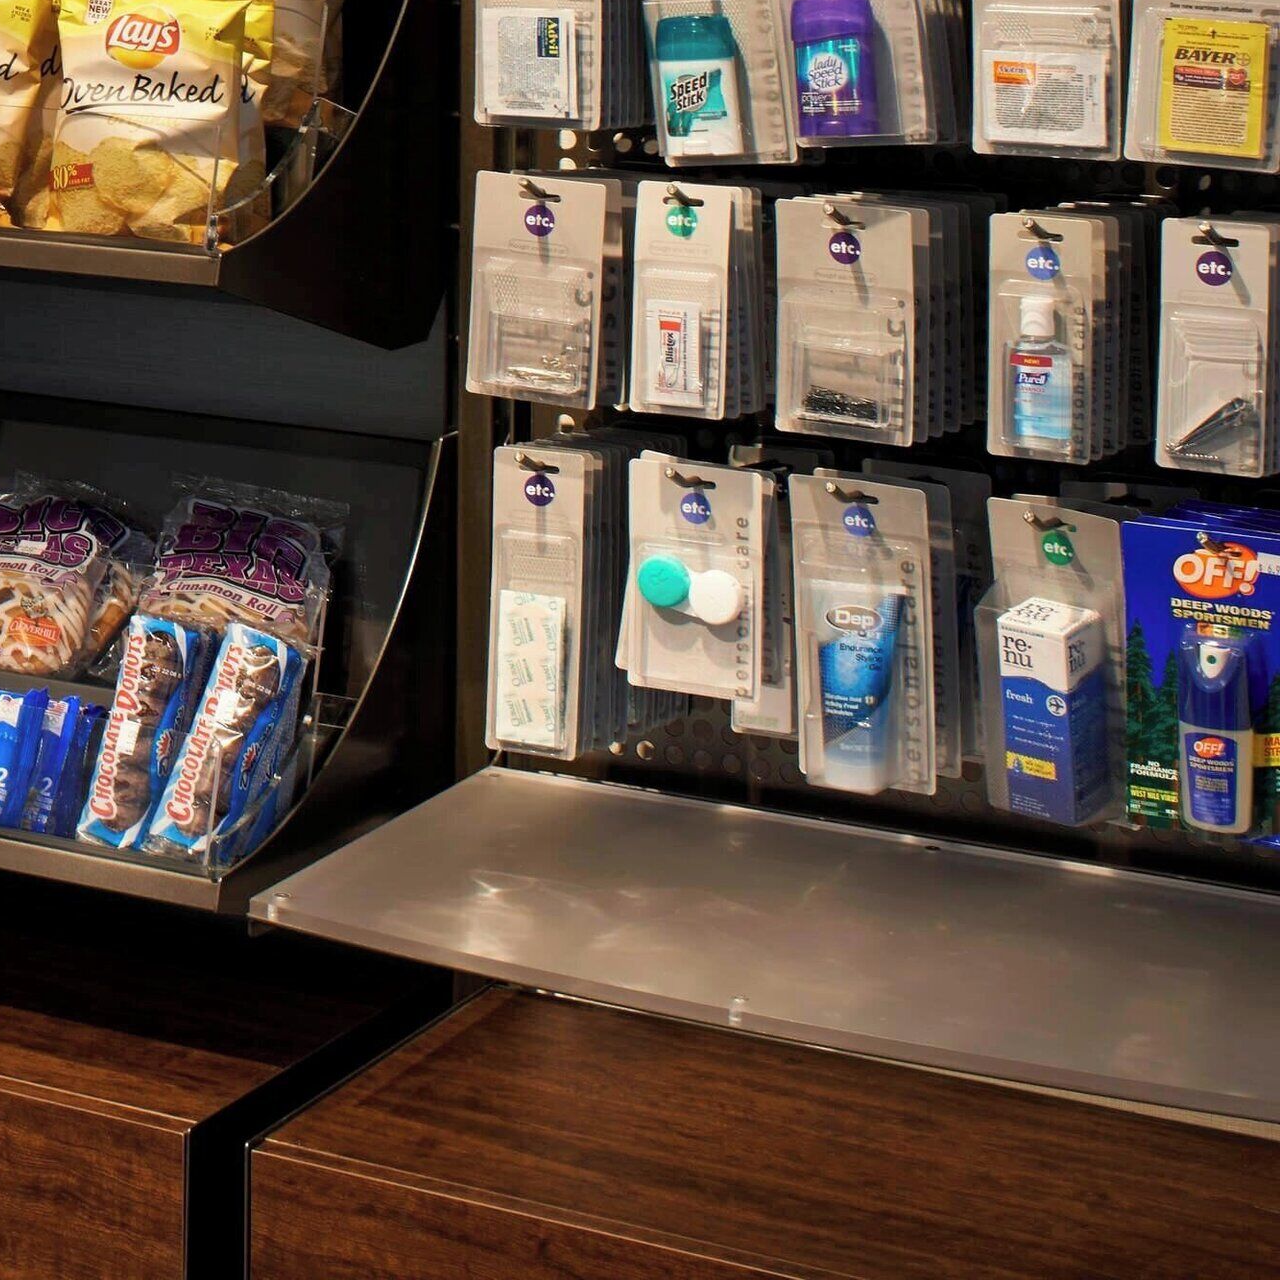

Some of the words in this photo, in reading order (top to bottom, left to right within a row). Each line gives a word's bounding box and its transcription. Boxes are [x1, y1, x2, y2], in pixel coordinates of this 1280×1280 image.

[108, 15, 180, 50] Lay's
[547, 18, 560, 57] Advil
[813, 55, 837, 71] lady
[1174, 48, 1237, 63] BAYER
[808, 64, 843, 82] Speed
[130, 76, 224, 104] Baked
[814, 75, 842, 91] Stick
[52, 165, 77, 189] 80%
[1198, 261, 1232, 275] etc.
[1018, 372, 1047, 384] Purell
[525, 484, 555, 498] etc.
[682, 502, 710, 515] etc.
[844, 515, 874, 528] etc.
[1044, 541, 1072, 557] etc.
[30, 563, 59, 578] Roll
[166, 581, 243, 604] Cinnamon
[245, 598, 278, 615] Roll
[1171, 598, 1215, 610] DEEP
[1216, 604, 1272, 620] WOODS
[835, 611, 874, 631] Dep
[1172, 609, 1270, 630] SPORTSMEN
[1006, 689, 1033, 705] fresh
[89, 711, 126, 820] CHOCOLATE
[117, 634, 144, 722] DONUTS
[1193, 740, 1224, 754] OFF!
[1190, 762, 1234, 773] SPORTSMEN
